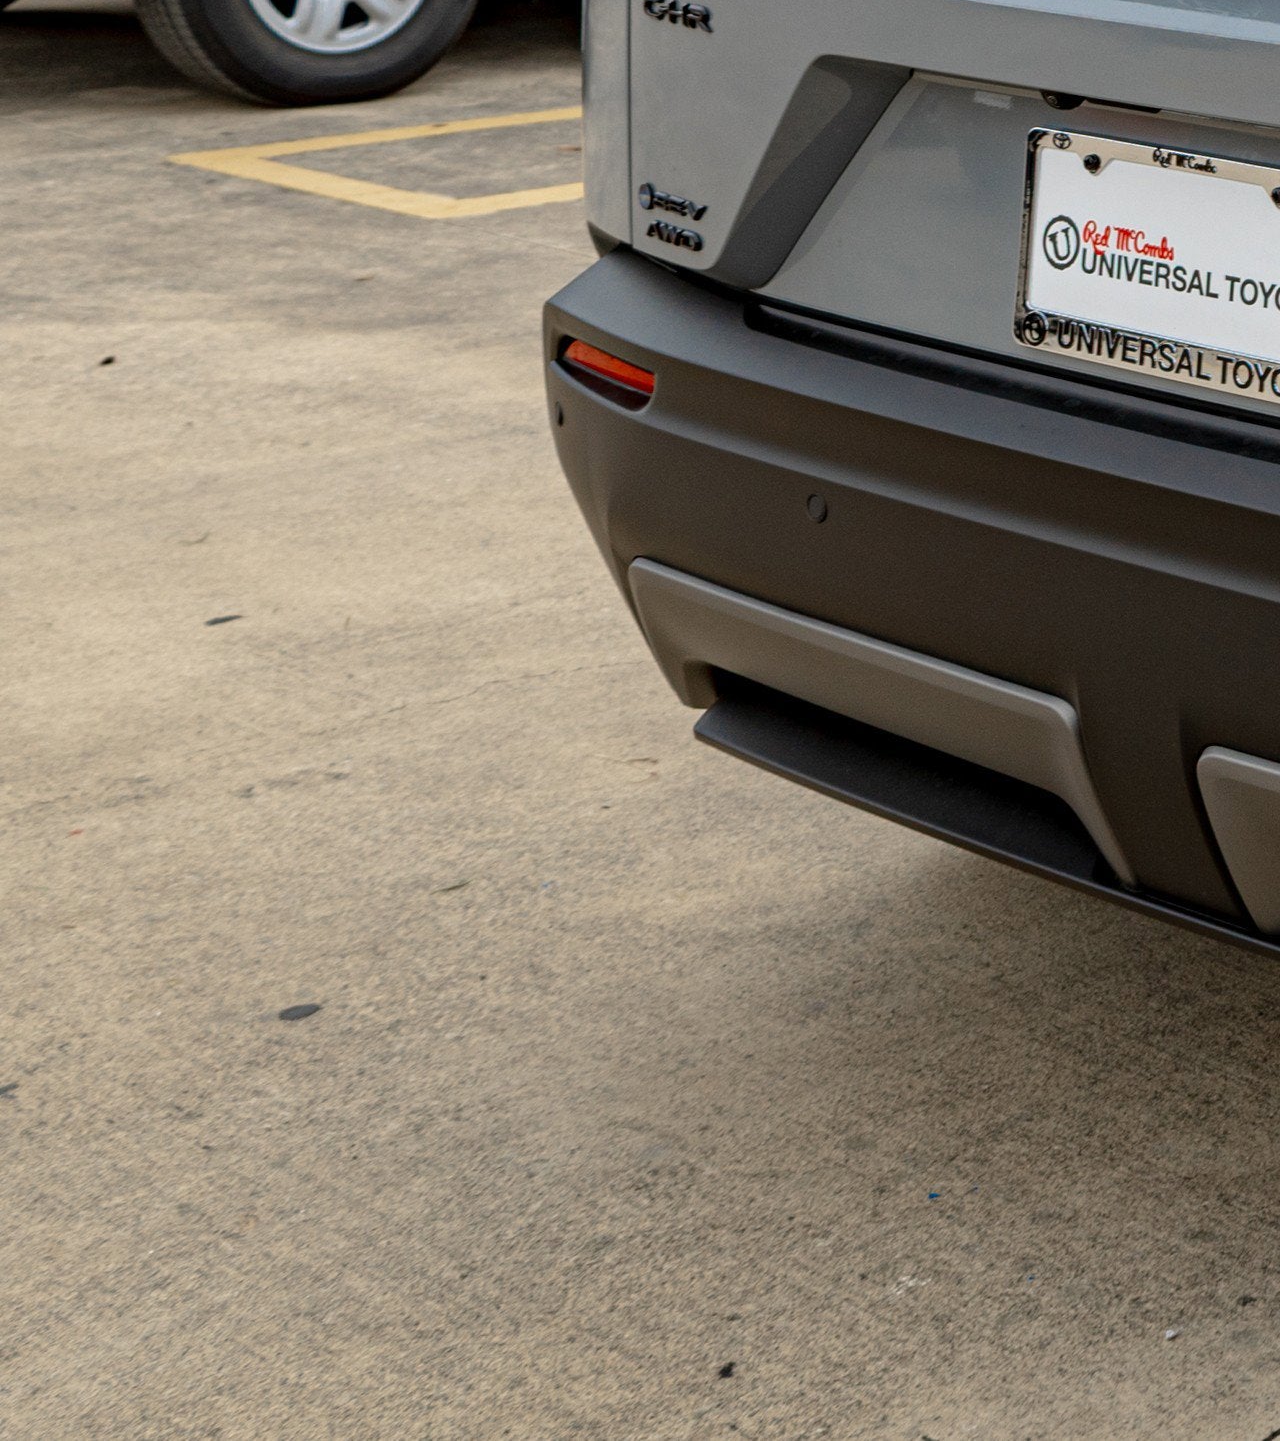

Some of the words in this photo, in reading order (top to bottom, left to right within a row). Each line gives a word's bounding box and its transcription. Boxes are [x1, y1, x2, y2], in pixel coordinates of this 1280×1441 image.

[1083, 219, 1110, 256] Red
[1114, 226, 1175, 261] McCombs
[1081, 248, 1219, 299] UNIVERSAL
[1056, 318, 1212, 381] UNIVERSAL
